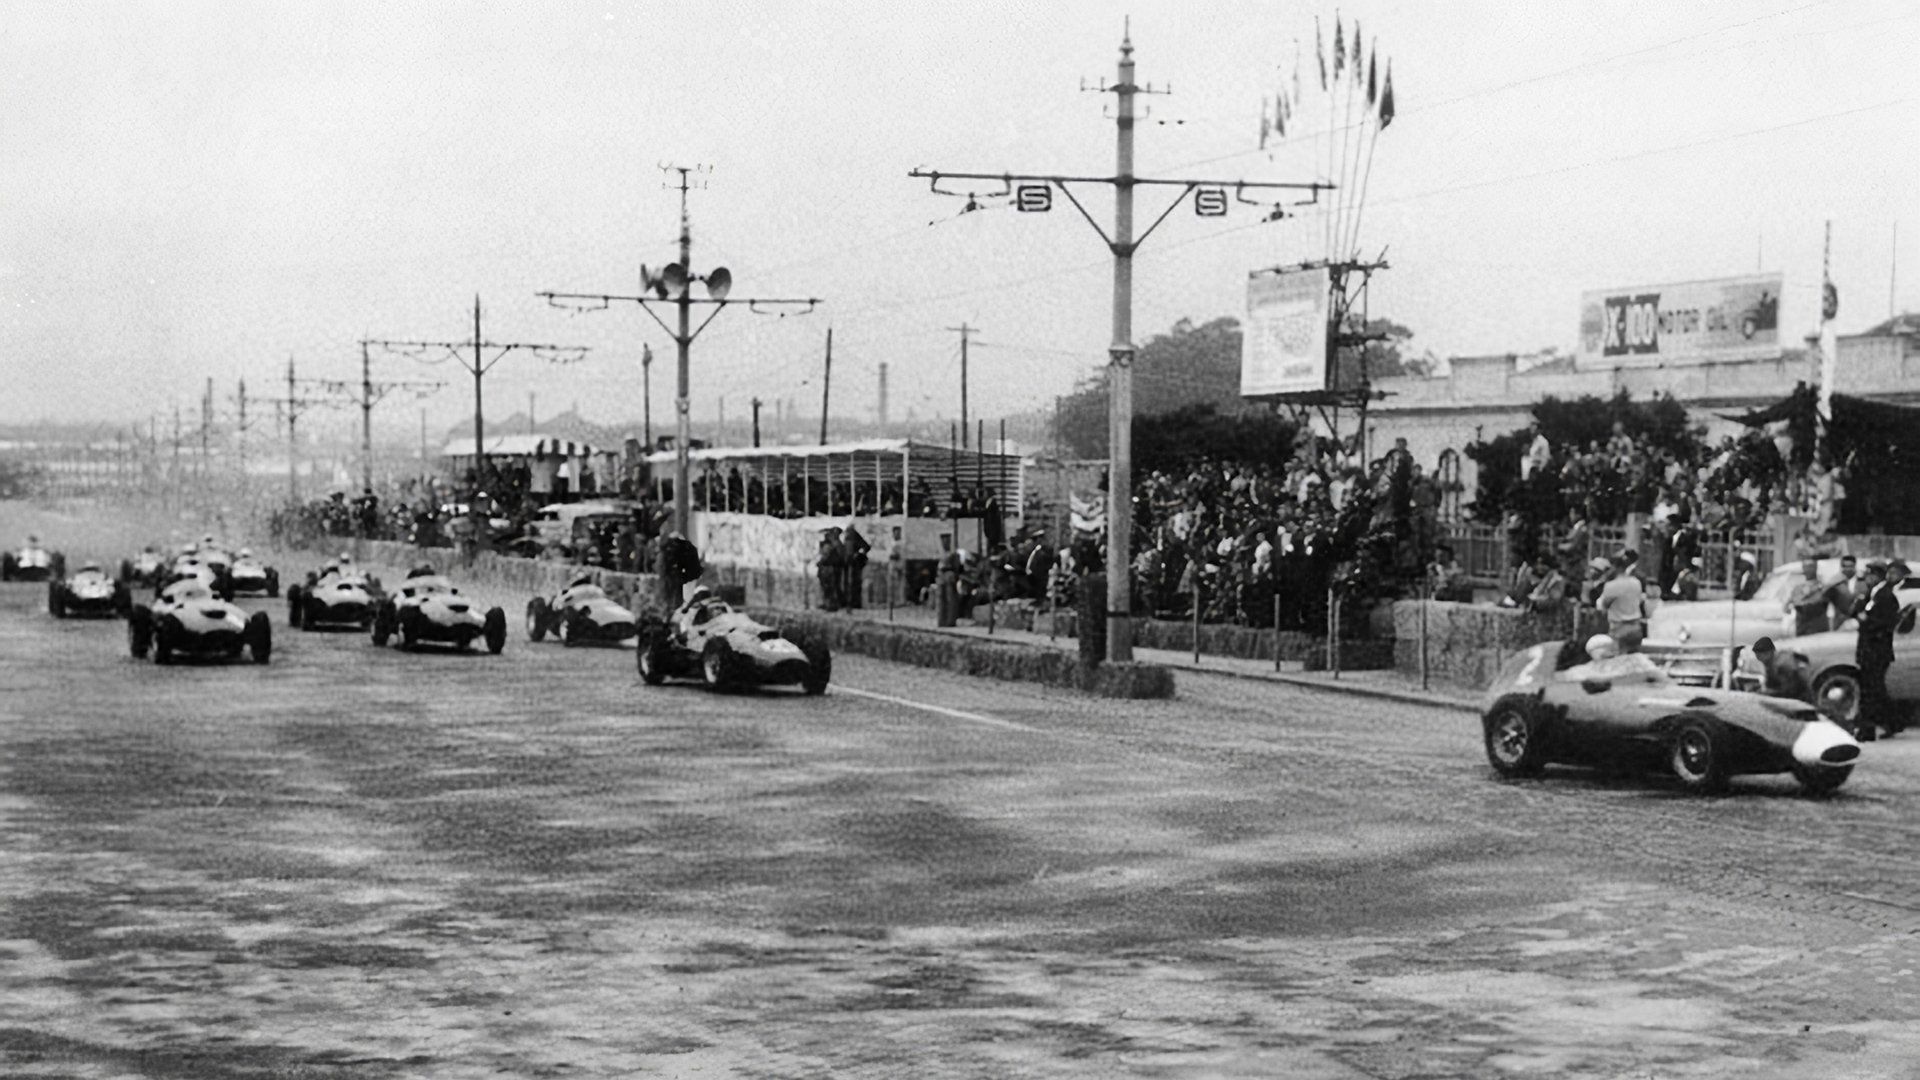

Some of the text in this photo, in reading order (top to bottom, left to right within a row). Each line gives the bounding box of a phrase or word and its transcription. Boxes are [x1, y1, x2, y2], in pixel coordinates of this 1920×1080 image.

[1606, 303, 1655, 347] X-100
[1658, 309, 1700, 334] MOTOR
[1517, 645, 1544, 685] 2
